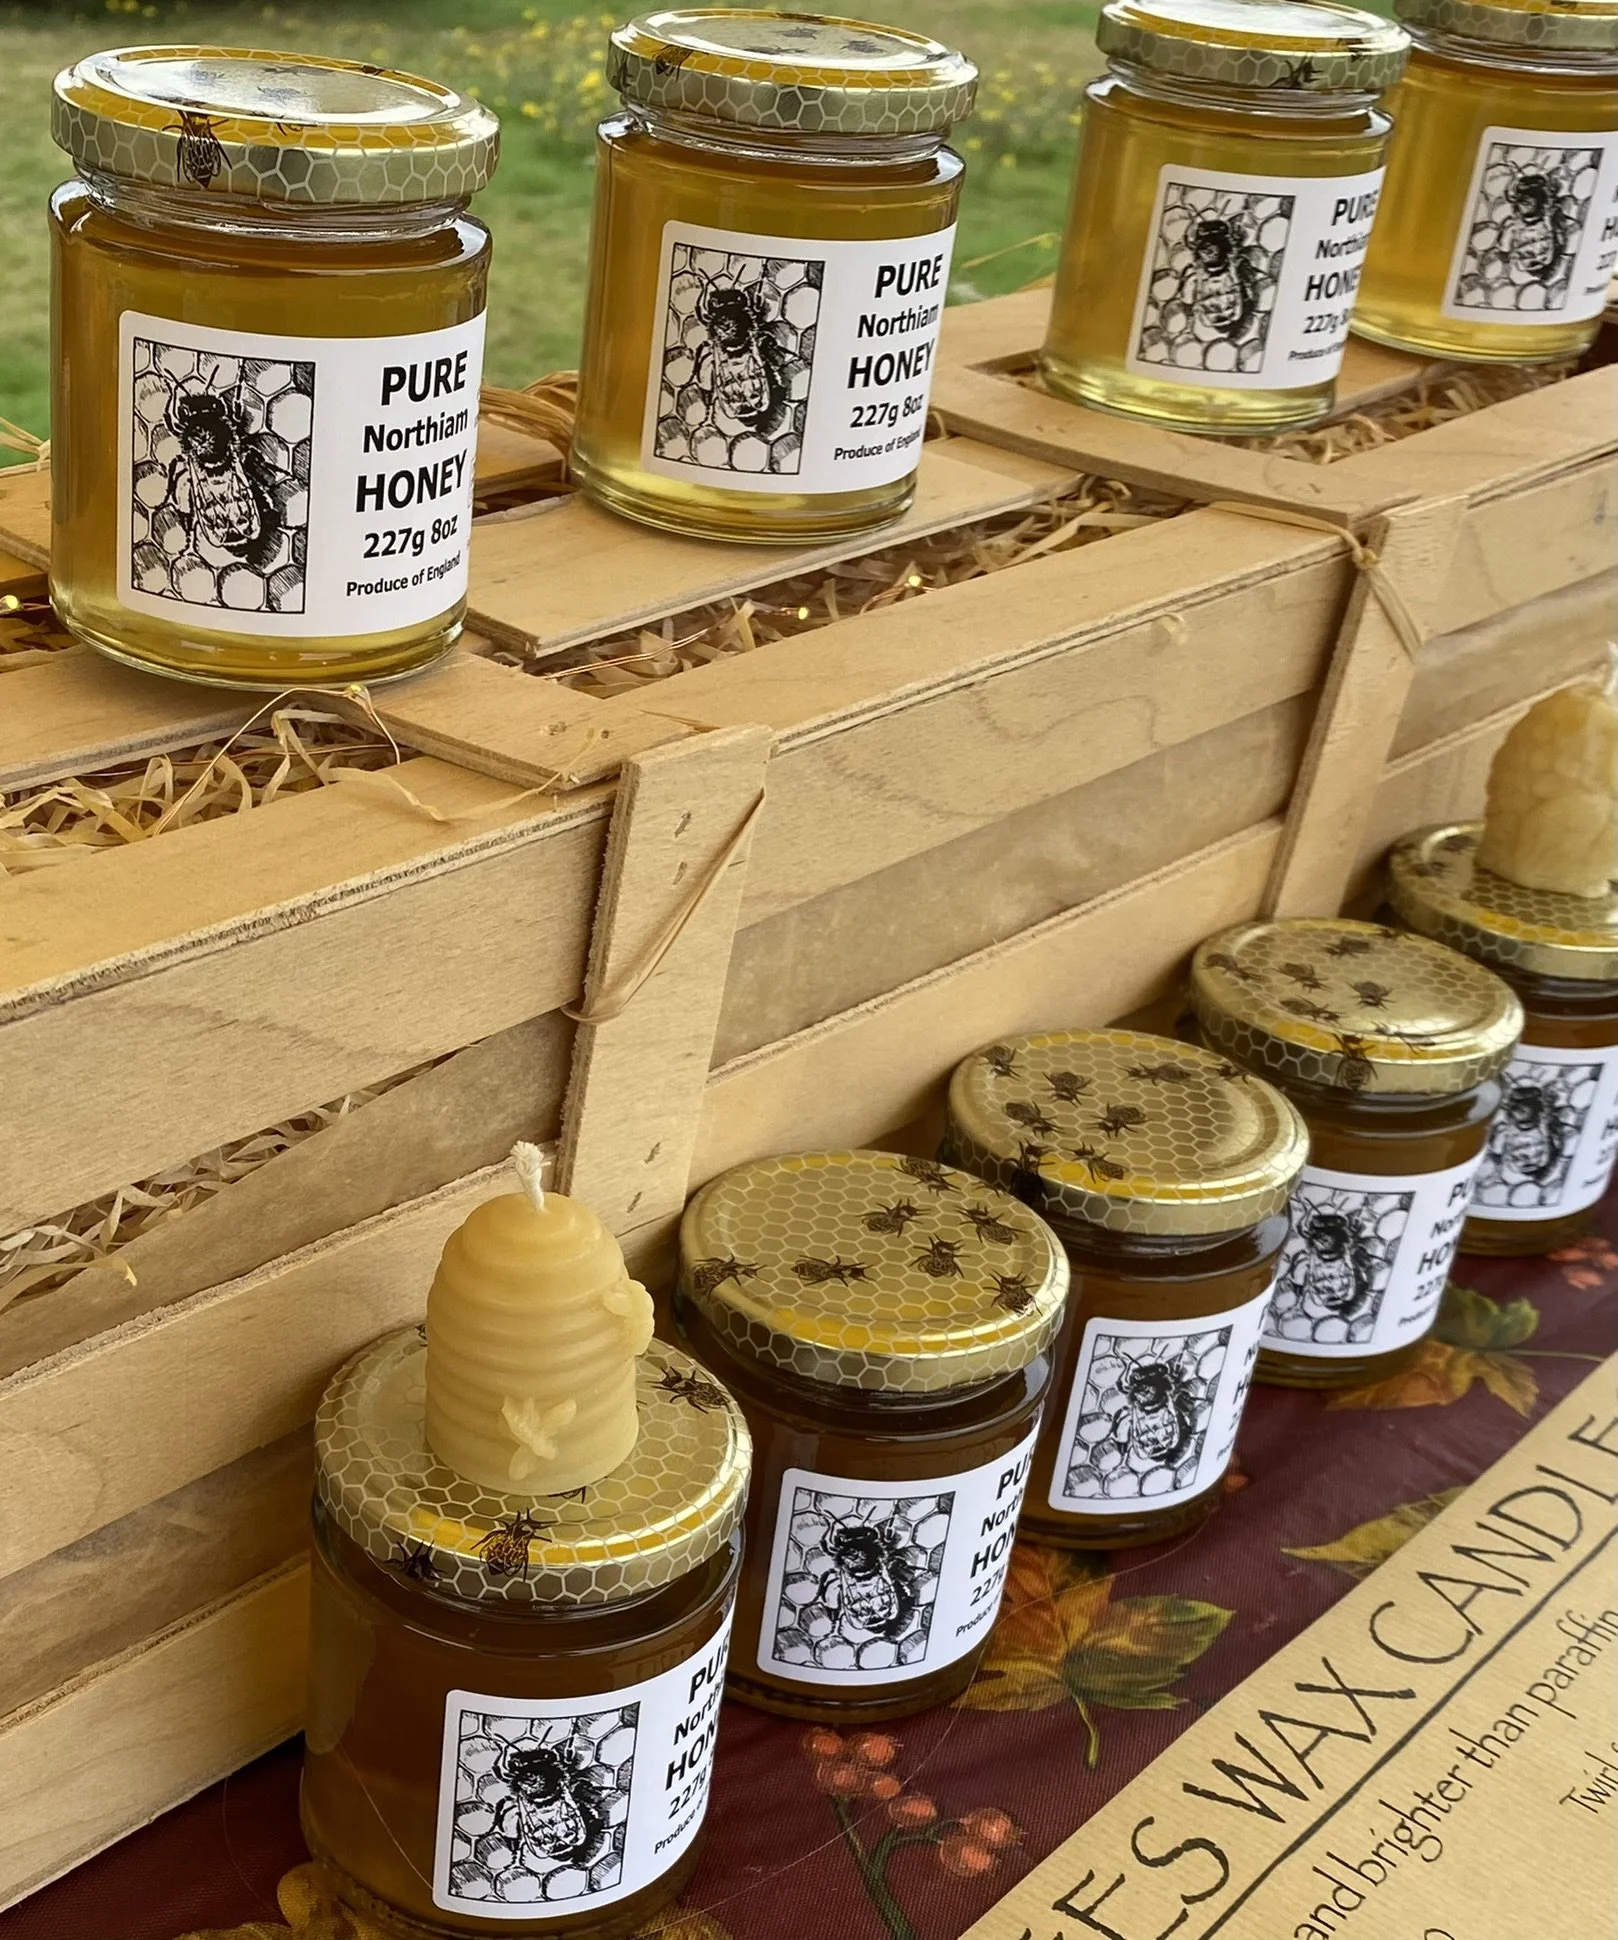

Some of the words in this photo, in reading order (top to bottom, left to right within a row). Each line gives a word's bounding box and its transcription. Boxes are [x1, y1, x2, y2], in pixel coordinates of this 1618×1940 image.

[874, 253, 943, 299] PURE
[1304, 264, 1363, 301] HONE
[857, 304, 939, 339] Northiam
[381, 350, 469, 406] PURE
[847, 338, 935, 389] HONEY
[363, 408, 468, 453] Northiam
[850, 402, 899, 428] 227g
[902, 393, 924, 418] 8oz
[834, 441, 883, 461] Produce
[885, 436, 897, 453] of
[355, 449, 468, 513] HONEY
[363, 527, 425, 558] 227g
[431, 514, 458, 545] 8oz
[346, 577, 408, 597] Produce
[411, 568, 424, 586] of
[426, 551, 461, 581] England
[970, 1520, 1015, 1580] HON
[688, 1627, 730, 1704] PUR
[1526, 1609, 1618, 1720] paraffin
[665, 1709, 719, 1791] HON
[1183, 1657, 1416, 1823] WAX
[1448, 1703, 1539, 1769] than
[668, 1769, 706, 1820] 227g
[654, 1810, 695, 1855] Produce
[1326, 1764, 1473, 1888] brighter
[1293, 1866, 1366, 1940] and
